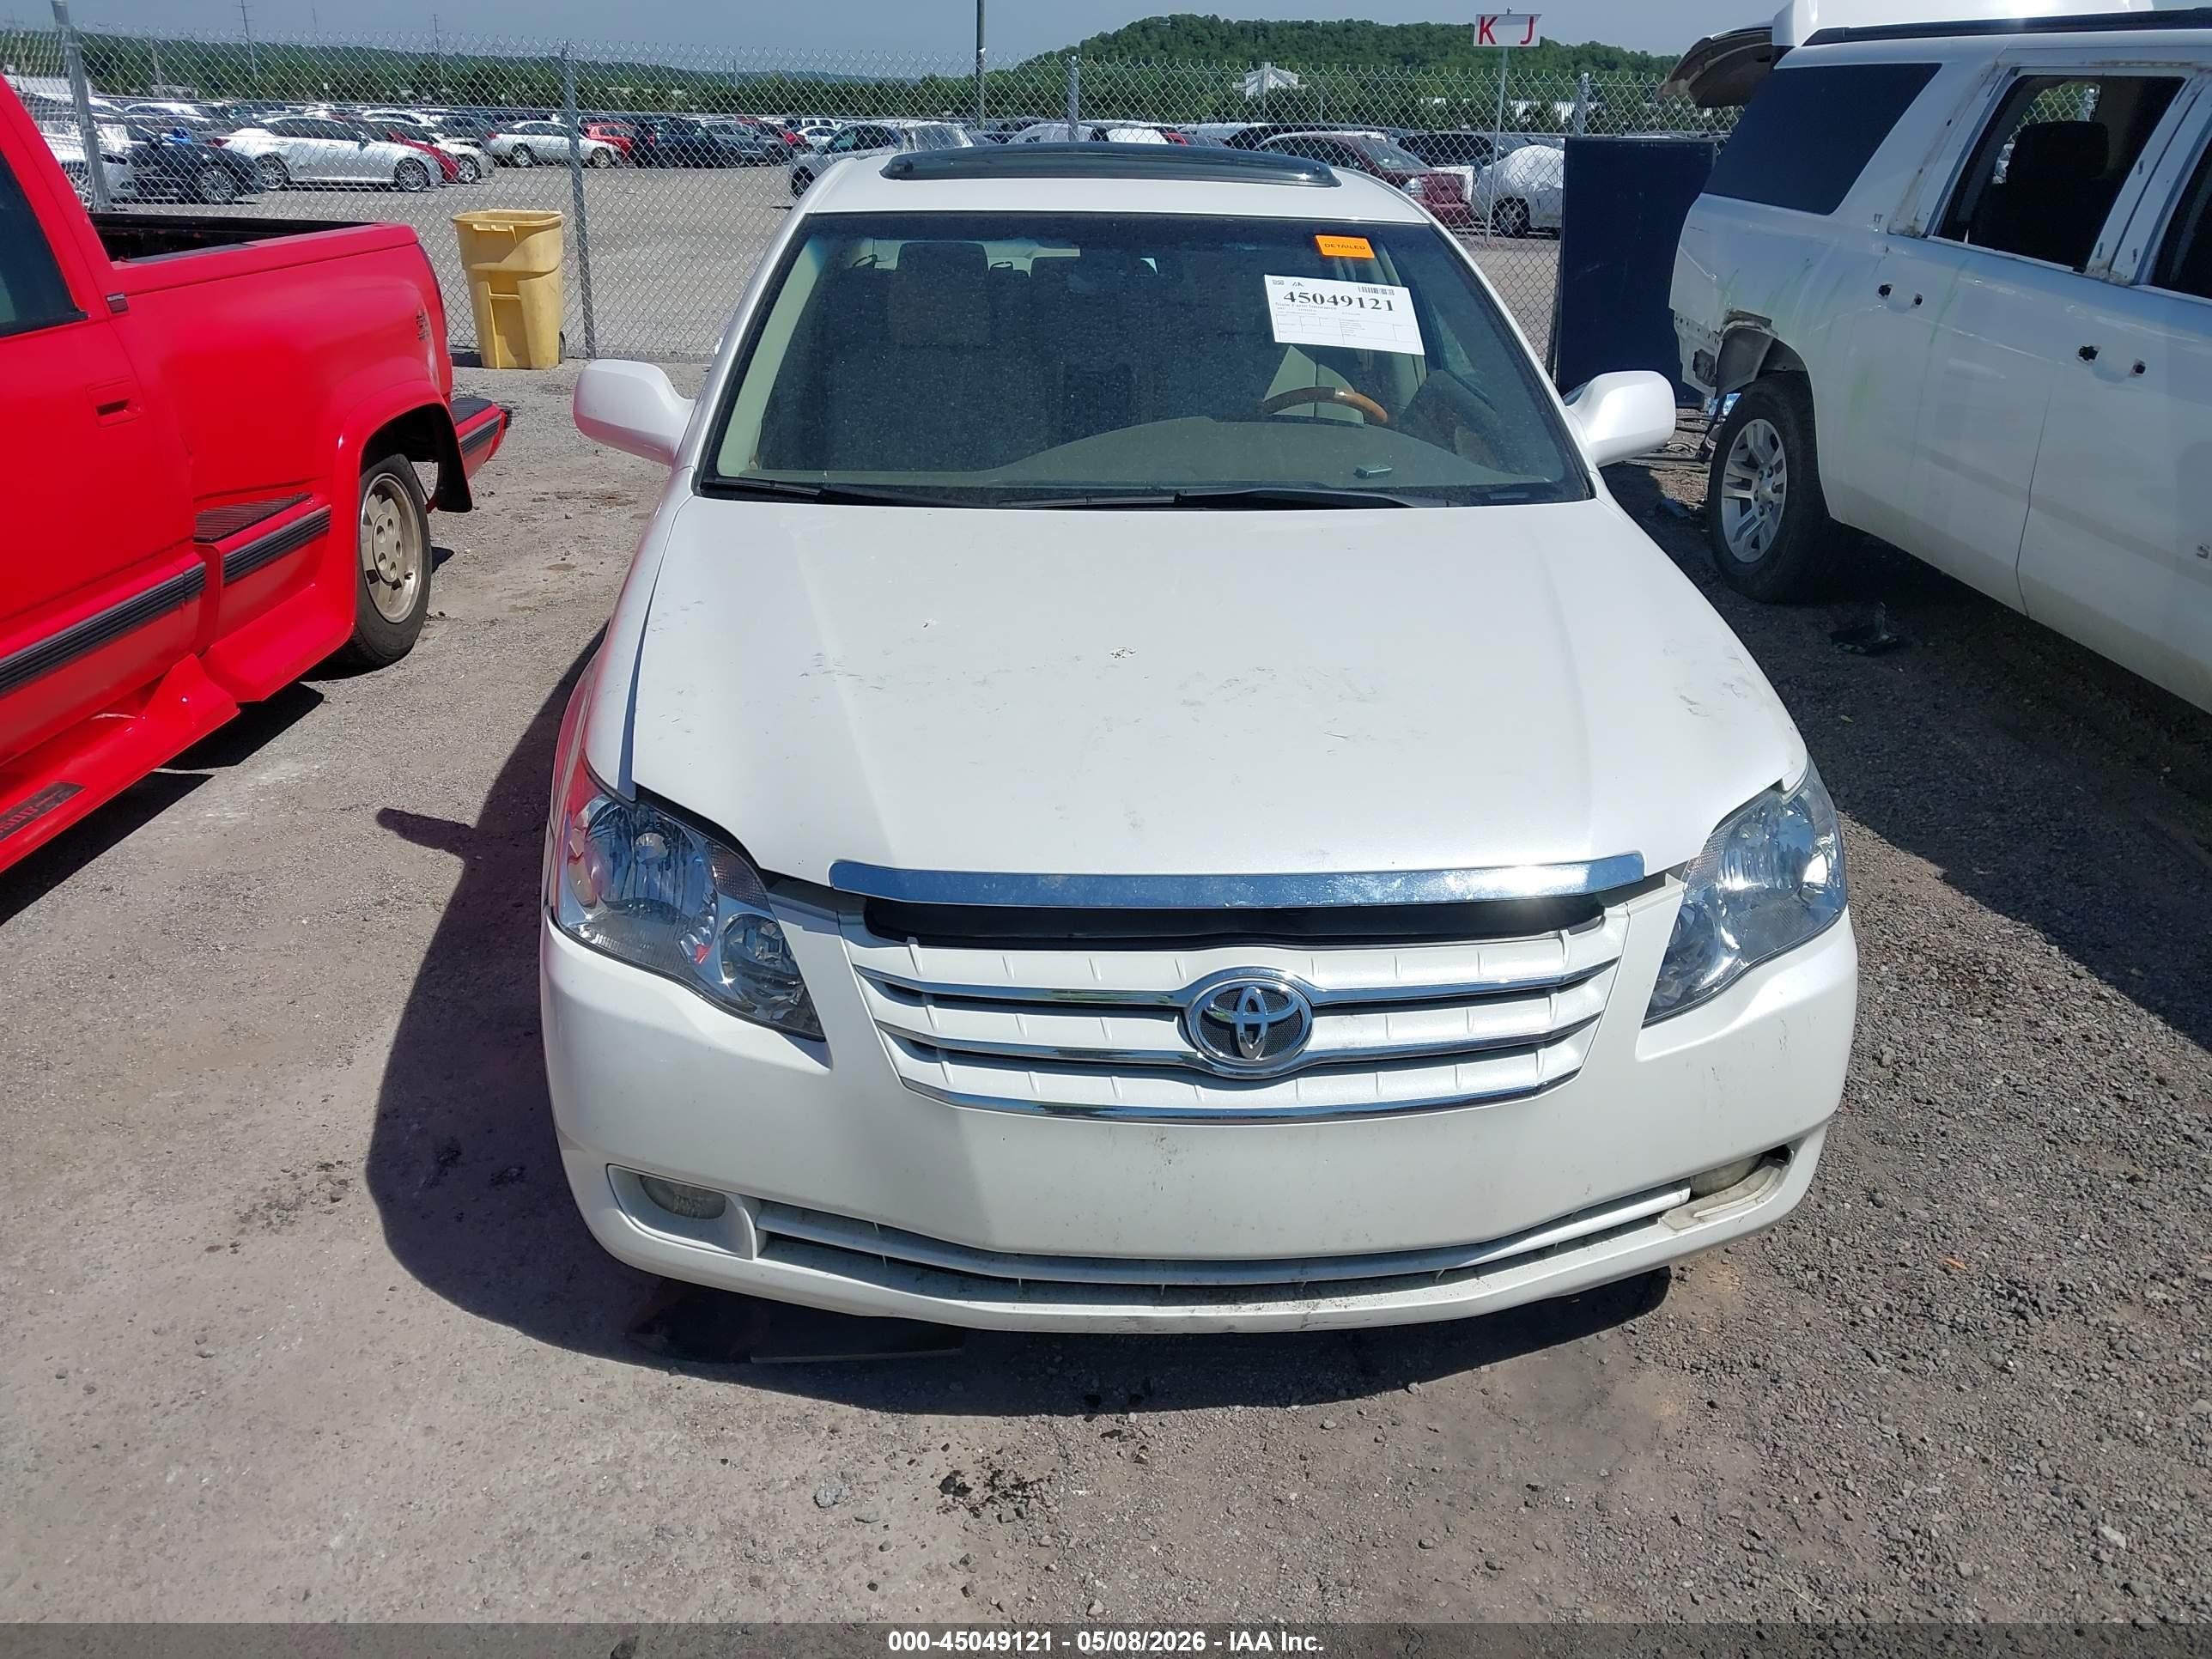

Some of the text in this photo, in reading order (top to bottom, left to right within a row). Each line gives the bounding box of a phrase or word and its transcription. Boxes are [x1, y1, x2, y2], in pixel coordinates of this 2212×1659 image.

[1479, 16, 1534, 45] K J
[1283, 291, 1395, 312] 45049121
